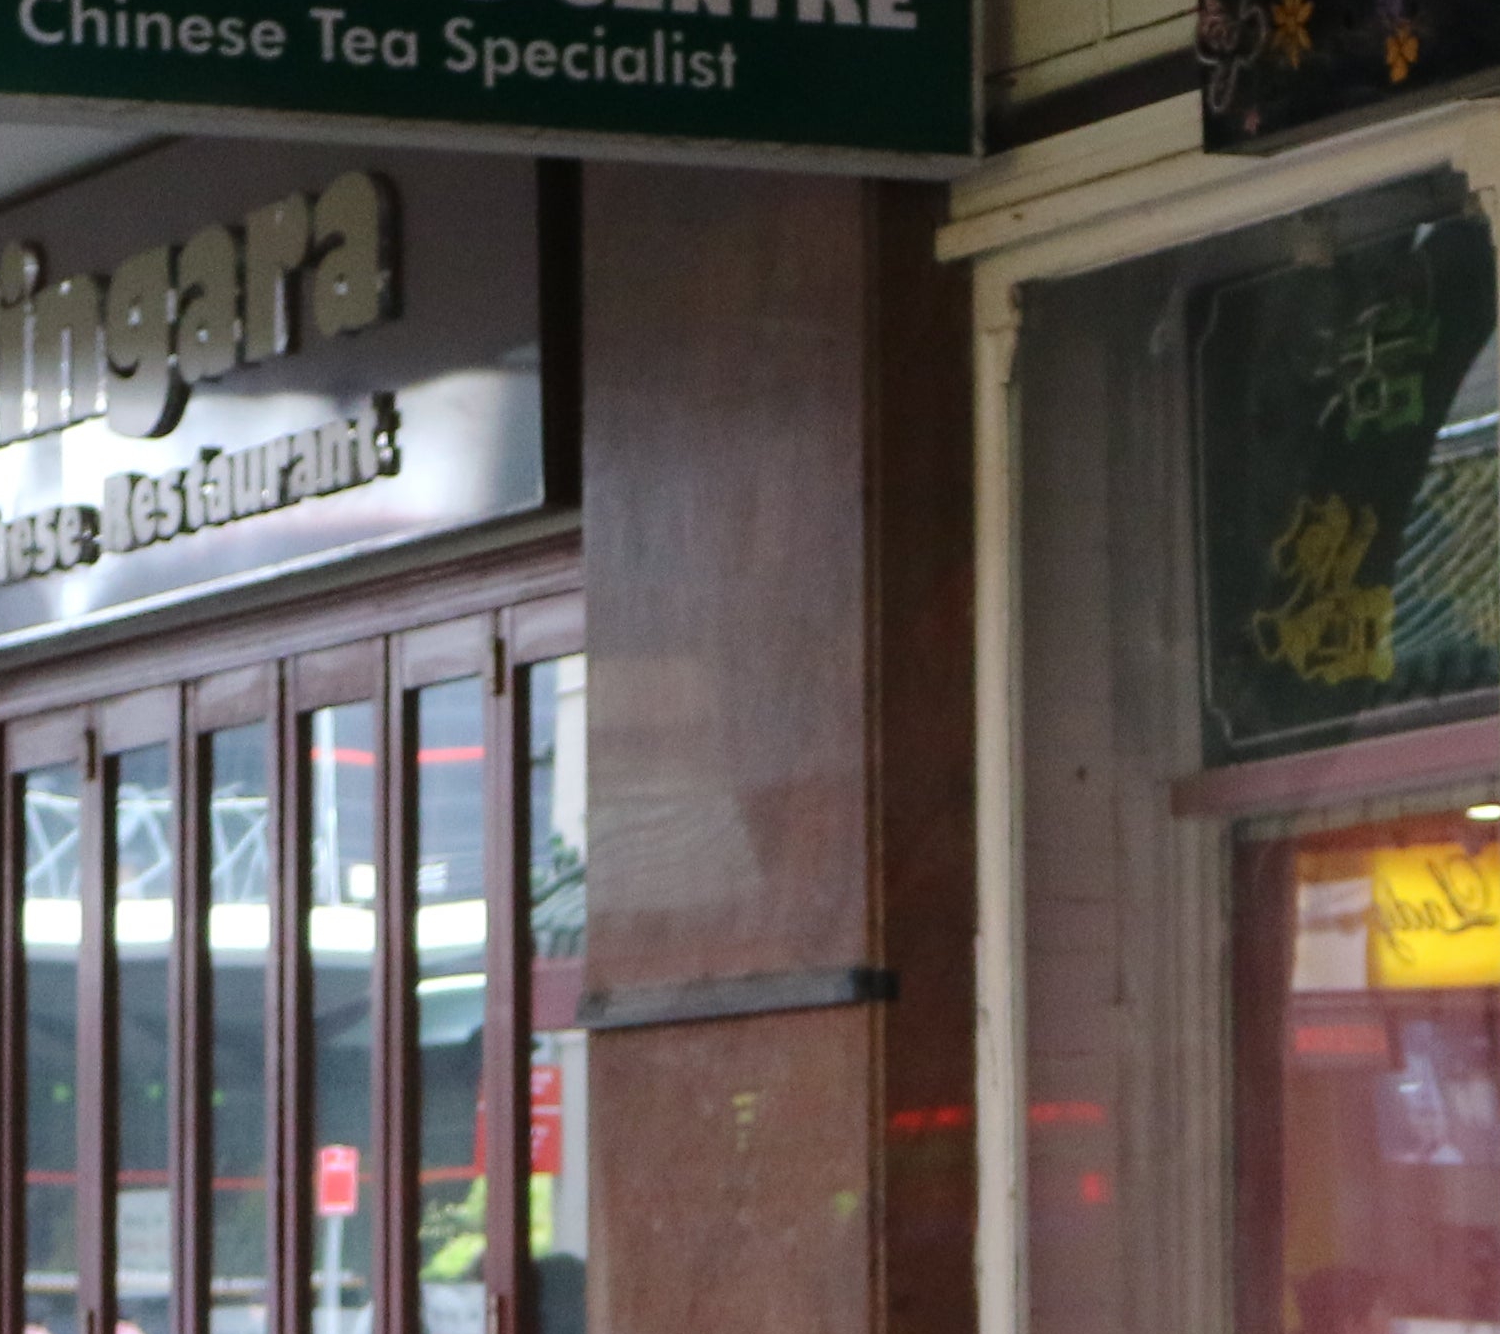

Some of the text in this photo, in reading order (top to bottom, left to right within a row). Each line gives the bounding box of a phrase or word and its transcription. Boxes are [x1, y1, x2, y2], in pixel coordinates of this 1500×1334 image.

[309, 8, 418, 69] Tea
[444, 17, 737, 89] Specialist
[102, 390, 400, 555] Restaurant
